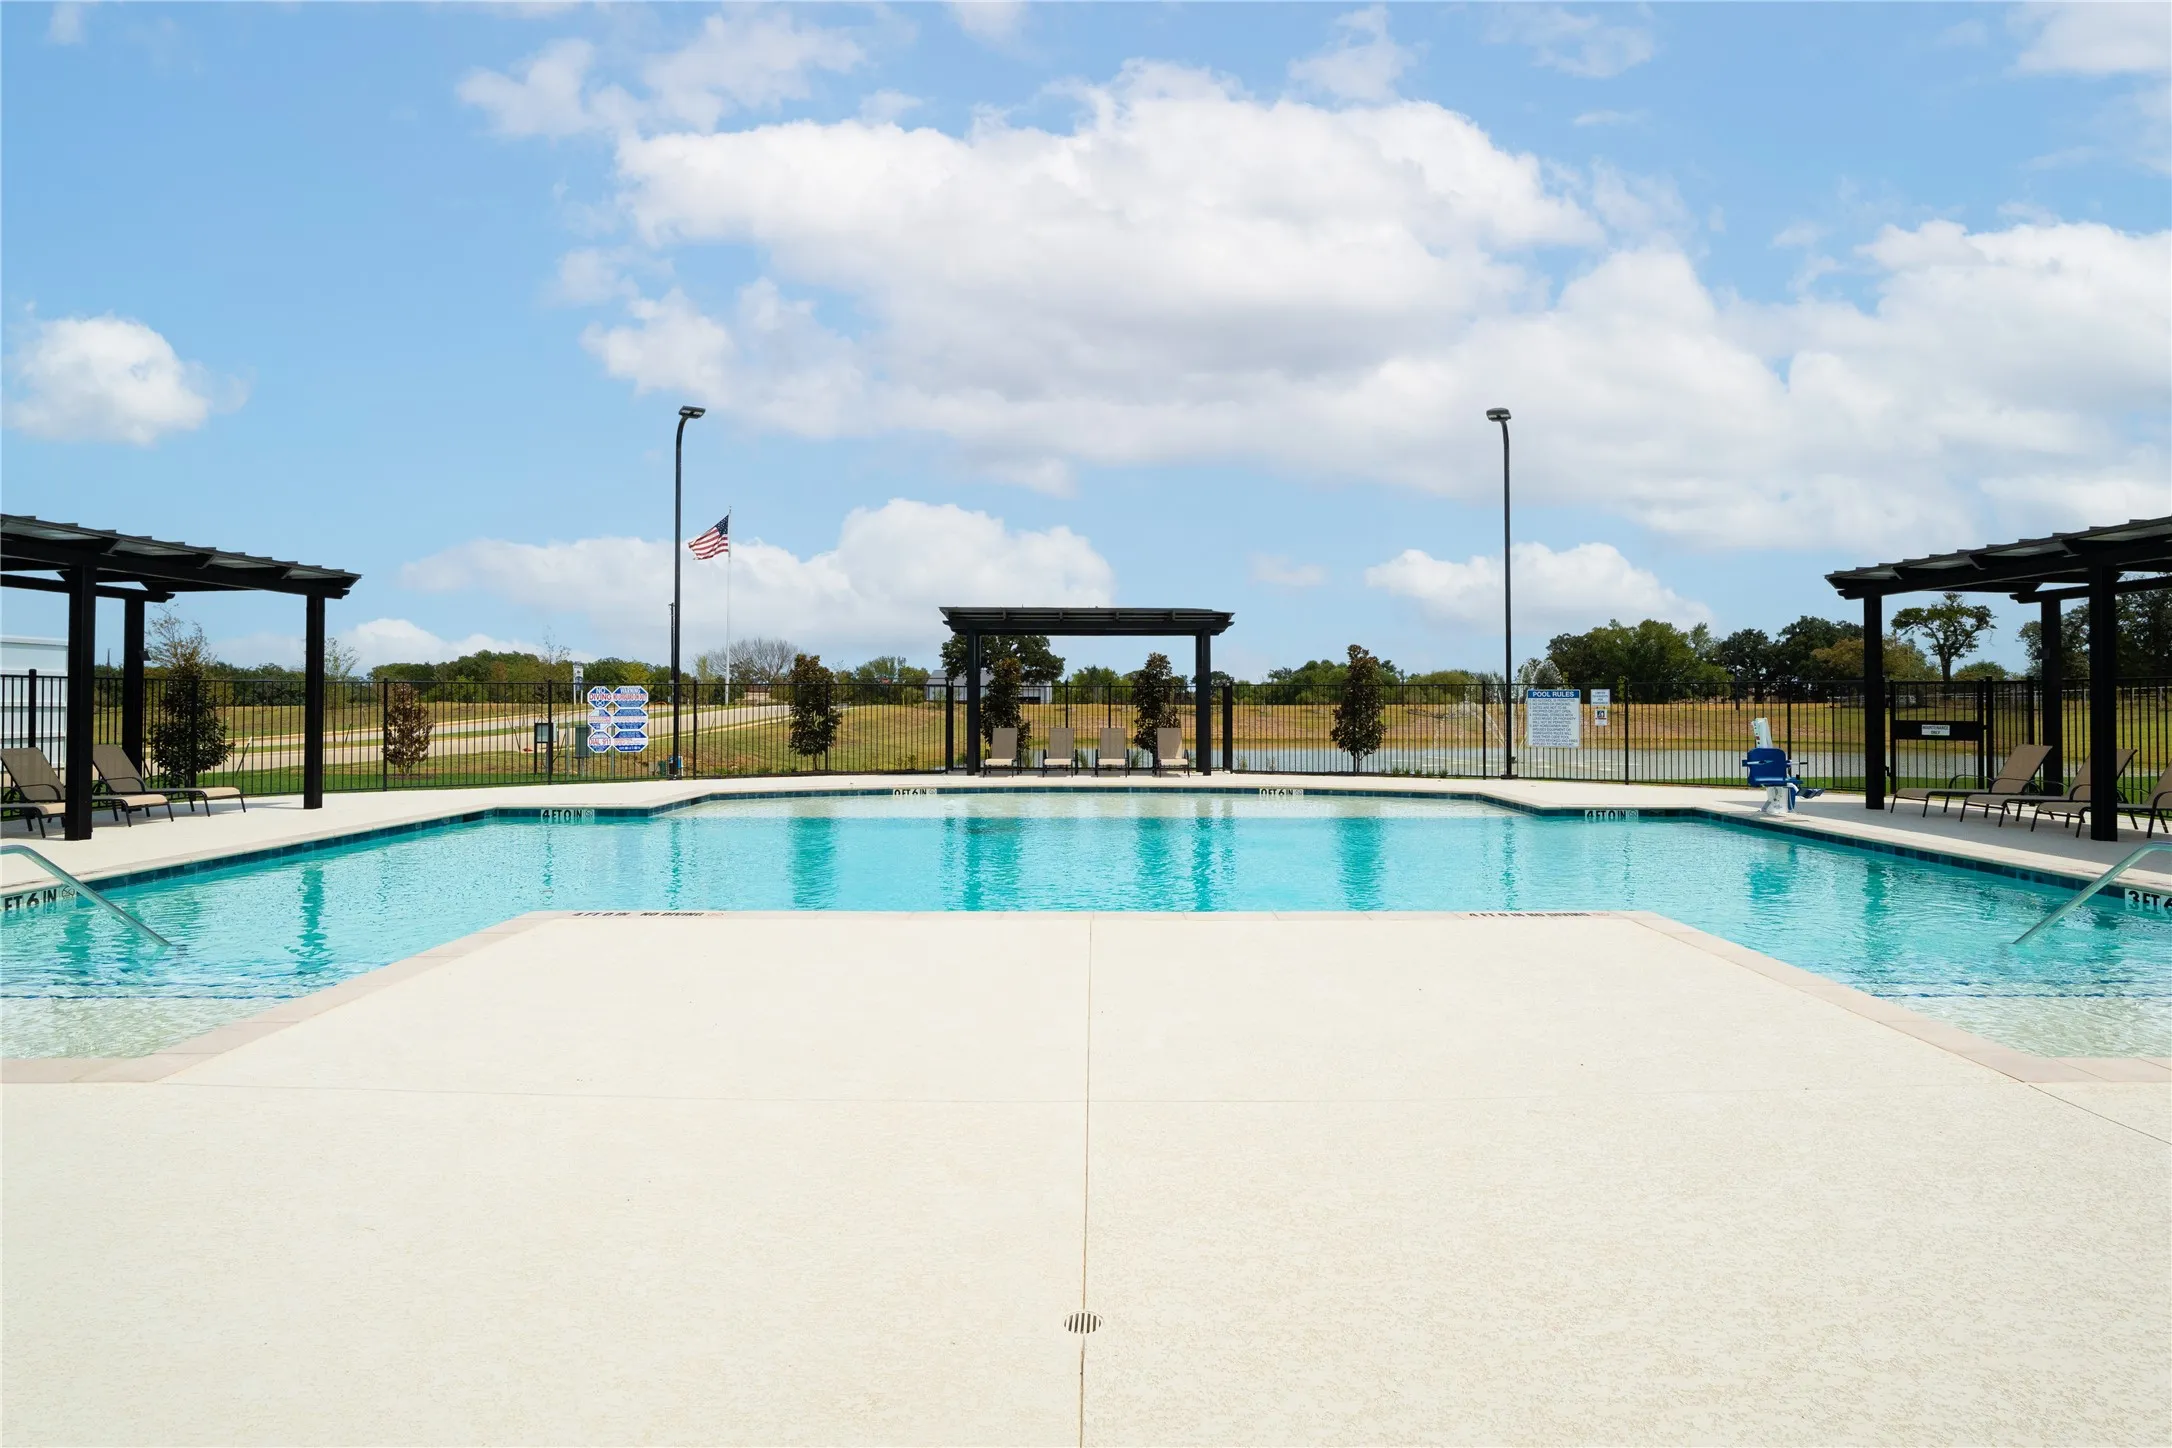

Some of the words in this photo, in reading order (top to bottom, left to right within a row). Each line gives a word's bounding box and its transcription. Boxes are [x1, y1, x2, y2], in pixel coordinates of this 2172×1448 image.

[542, 809, 550, 818] 4
[1587, 810, 1594, 818] 4
[4, 895, 23, 911] FT
[27, 892, 40, 907] 6
[43, 888, 57, 903] IN
[2128, 890, 2140, 903] 3
[2143, 892, 2160, 906] FT
